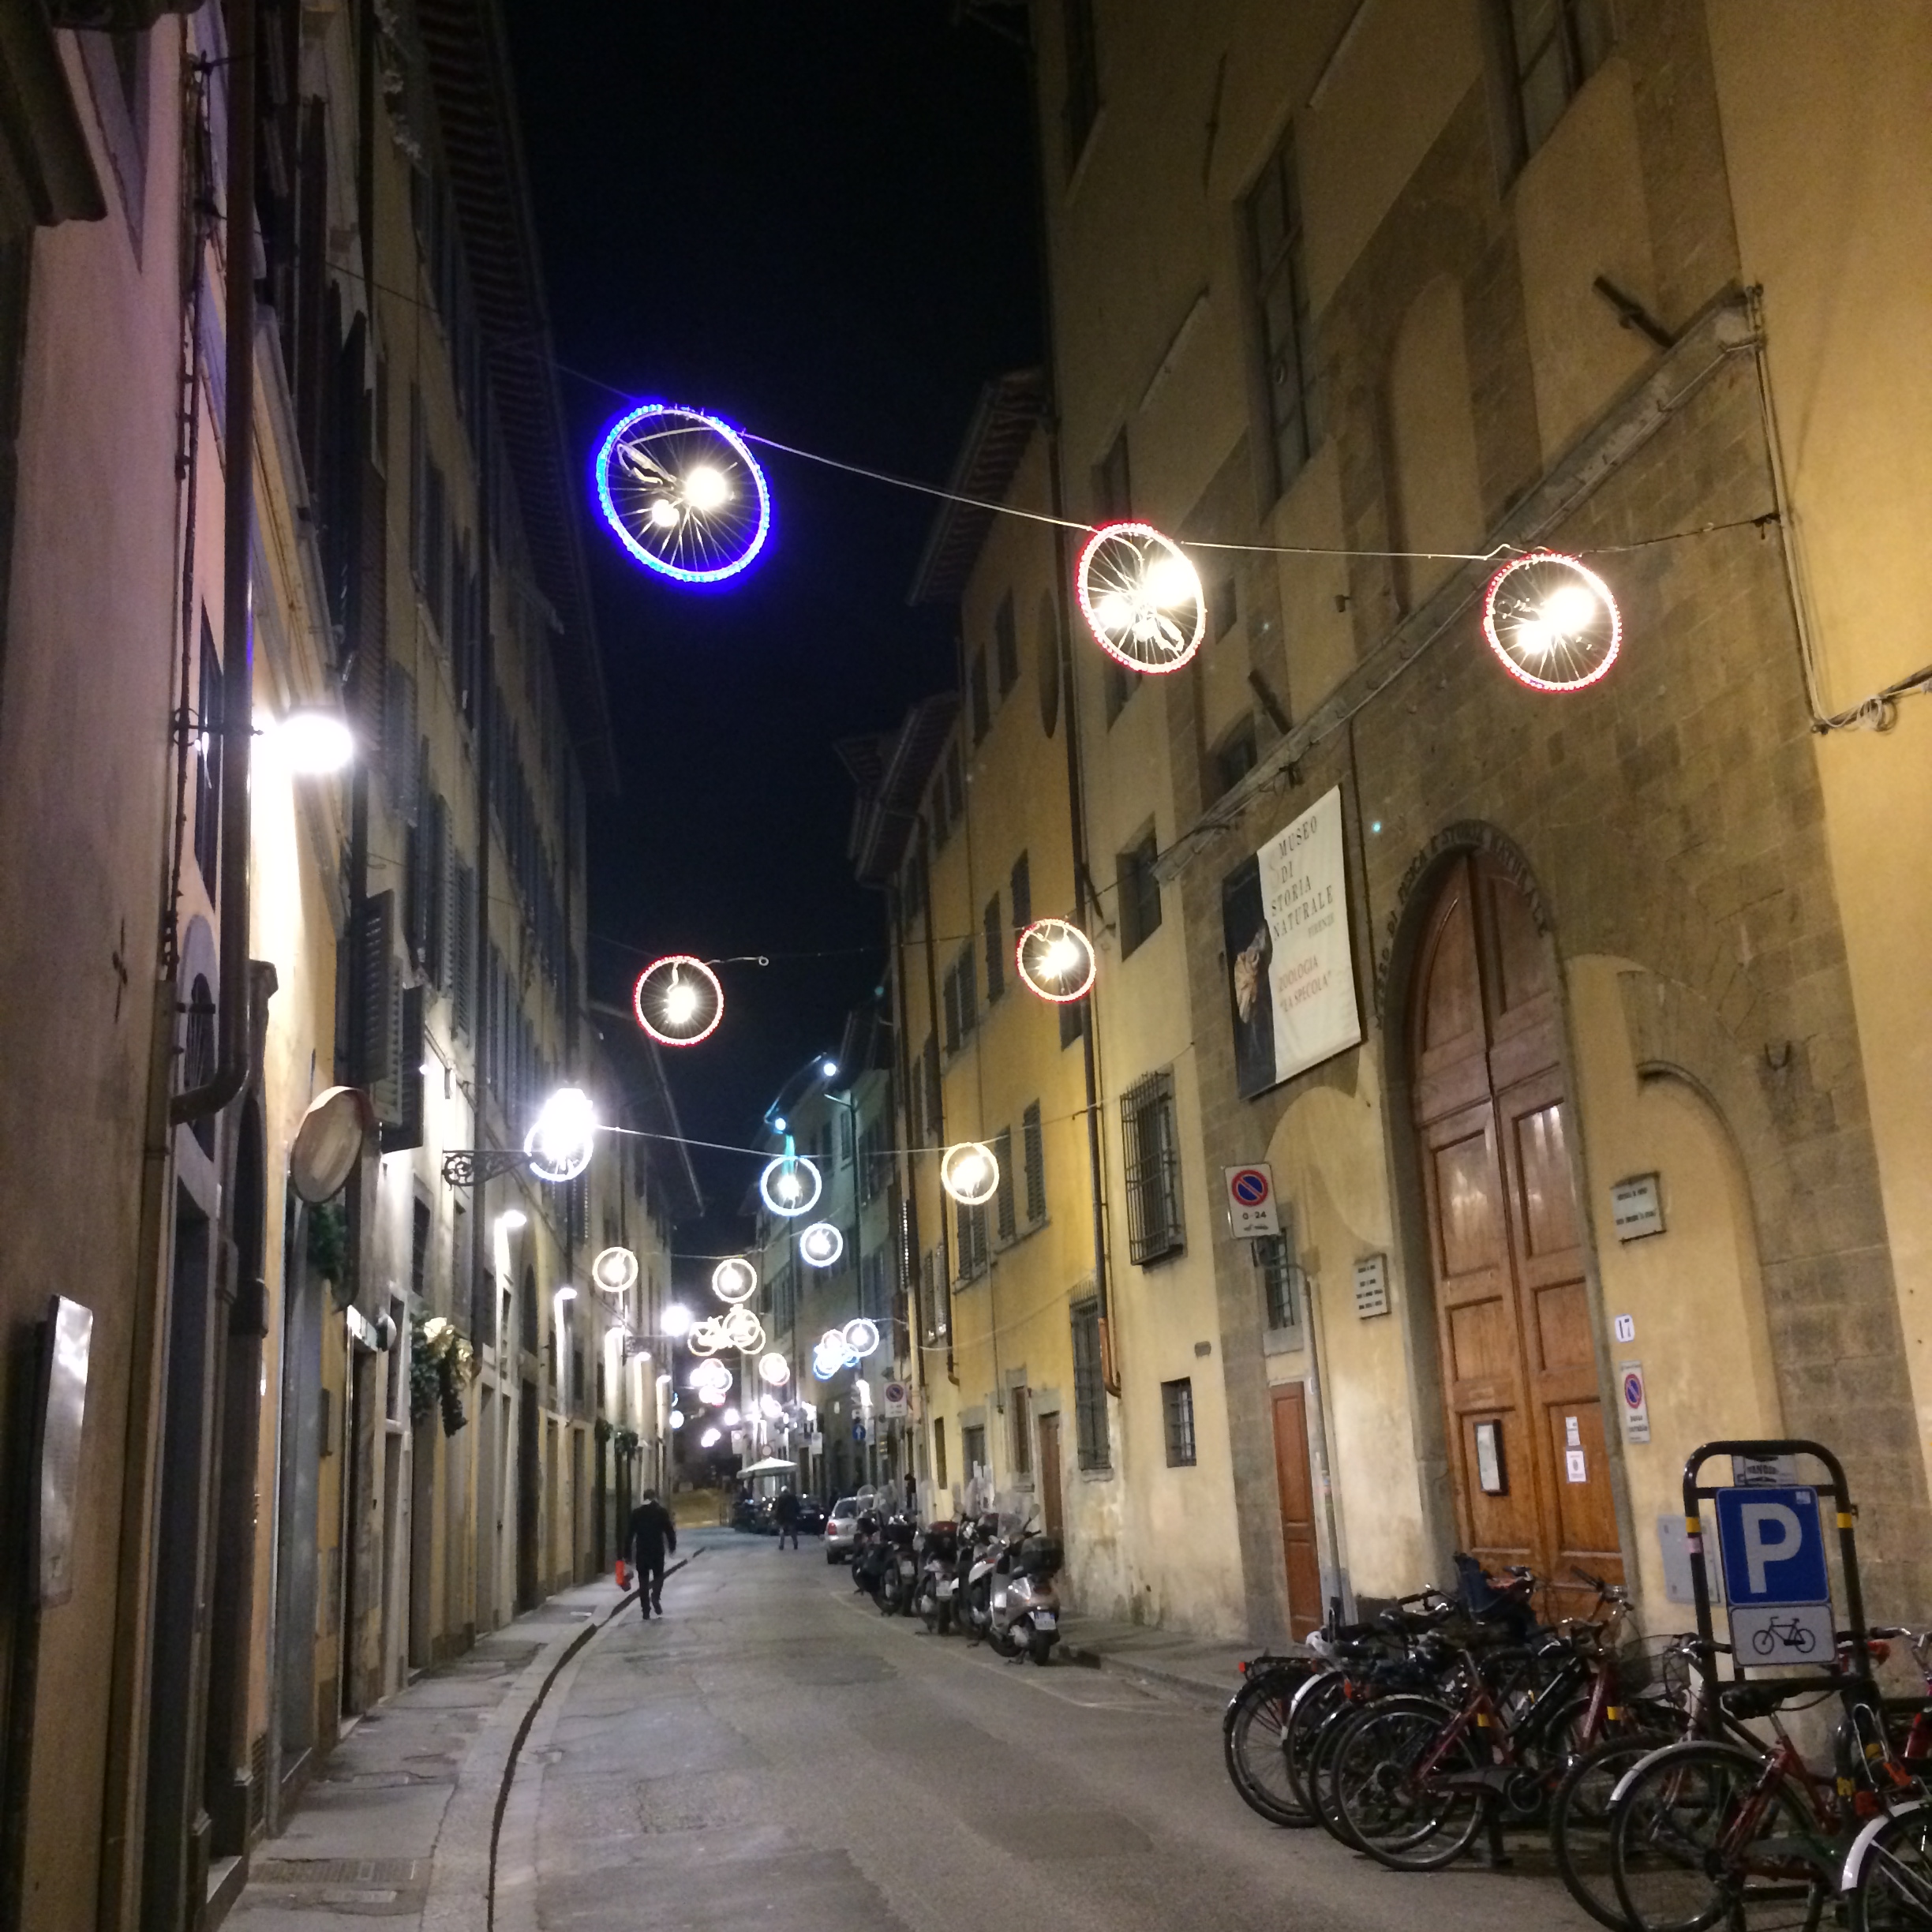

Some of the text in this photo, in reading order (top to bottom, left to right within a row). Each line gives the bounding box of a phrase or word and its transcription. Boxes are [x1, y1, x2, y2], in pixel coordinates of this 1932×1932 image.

[1279, 815, 1318, 859] MUSEO
[1281, 860, 1294, 884] DI
[1271, 875, 1312, 916] STORIA
[1272, 885, 1334, 942] NATURALE
[1278, 955, 1319, 993] ZOOLOGIA
[1741, 1503, 1803, 1594] P
